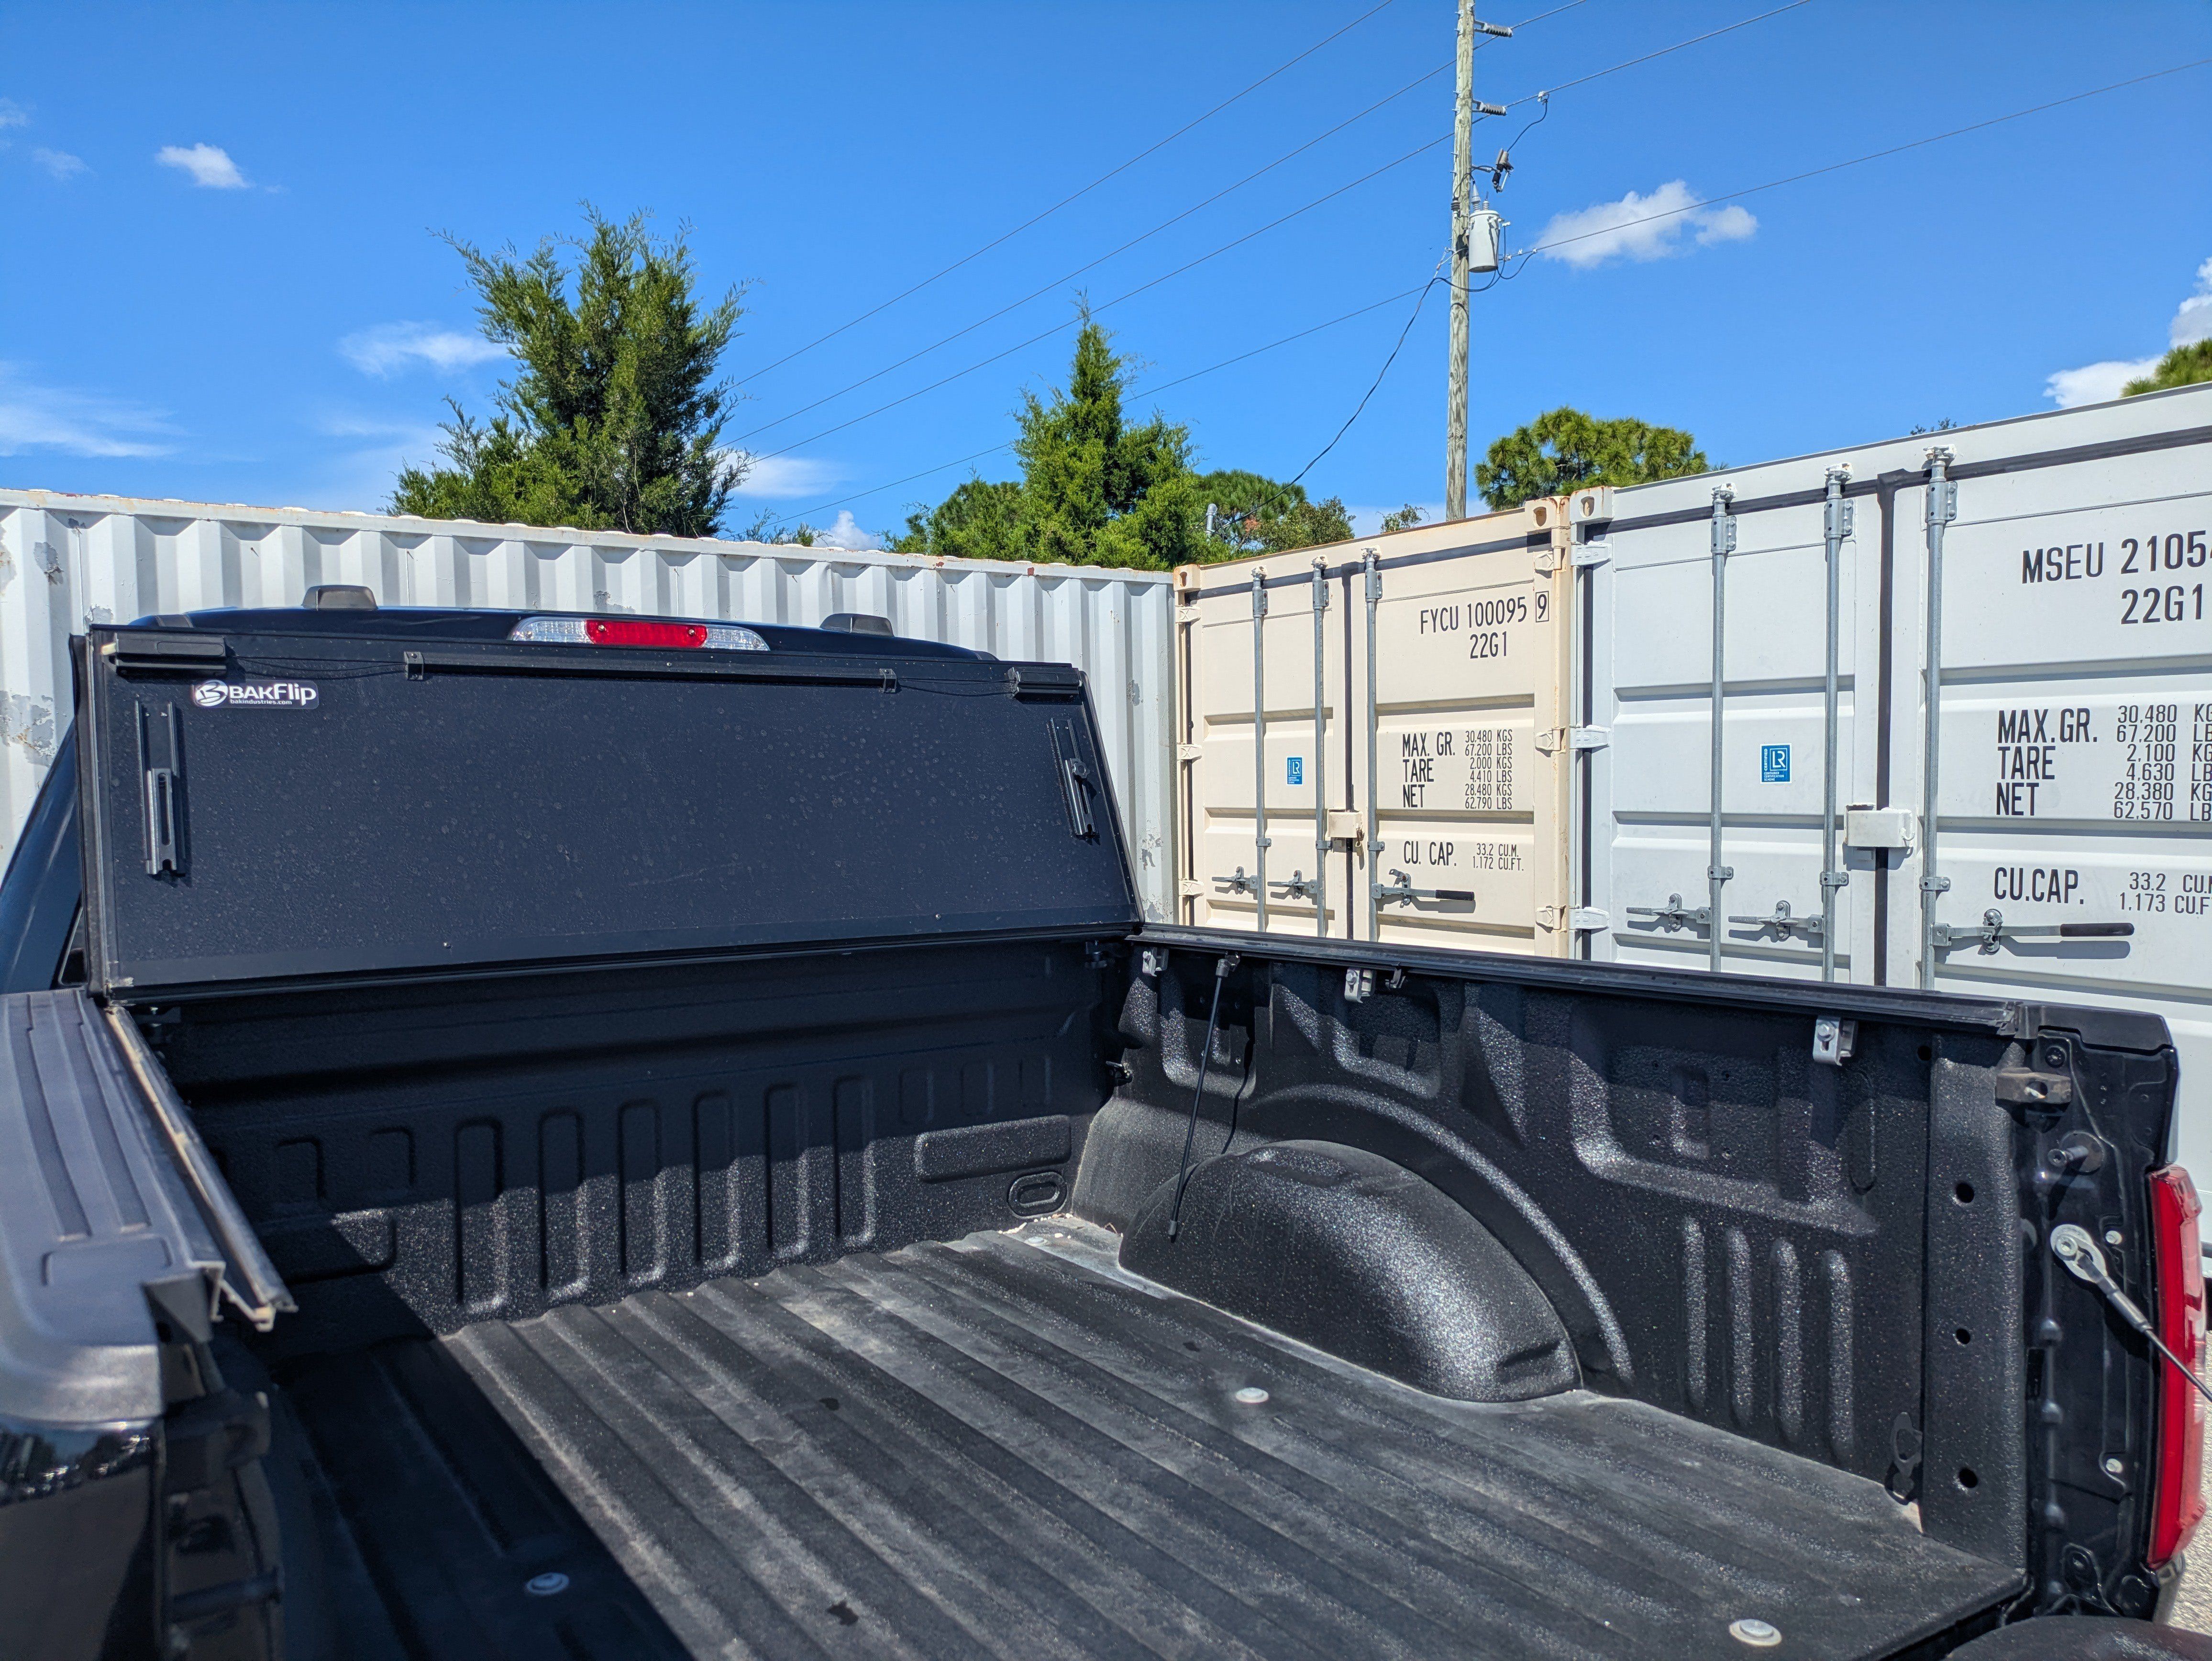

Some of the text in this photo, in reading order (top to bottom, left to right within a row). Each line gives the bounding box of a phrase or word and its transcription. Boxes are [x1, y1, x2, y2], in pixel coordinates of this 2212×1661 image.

[2022, 530, 2212, 584] MSEU 2105
[2121, 584, 2202, 624] 22G1
[1421, 593, 1548, 634] FYCU 100095 9
[1470, 631, 1506, 659] 22G1
[229, 683, 316, 706] BAKFlip
[2118, 705, 2177, 723] 30,480
[1465, 729, 1513, 742] 30,480 KGS
[2117, 724, 2176, 742] 67,200
[1403, 731, 1455, 757] MAX. GR.
[1465, 743, 1512, 756] 67,200 LBS
[2127, 743, 2175, 762] 2,100
[1470, 756, 1512, 769] 2,000 KGS
[1773, 751, 1785, 768] LR
[1997, 745, 2056, 780] TARE
[1403, 758, 1434, 783] TARE
[1470, 770, 1512, 782] 4,410 LBS
[2126, 763, 2174, 781] 4,630
[1403, 785, 1425, 808] NET
[1465, 784, 1512, 796] 28,480 KGS
[1996, 782, 2039, 816] NET
[2114, 782, 2174, 800] 28,380
[1465, 797, 1512, 809] 62,790 LBS
[2114, 801, 2173, 819] 62,570
[1404, 841, 1456, 866] CU. CAP.
[1477, 843, 1518, 857] 33.2 CU.M.
[1473, 856, 1524, 871] 1,172 CU.FT.
[2129, 872, 2212, 894] 33.2 CU.
[2120, 892, 2212, 915] 1,173 CU.F
